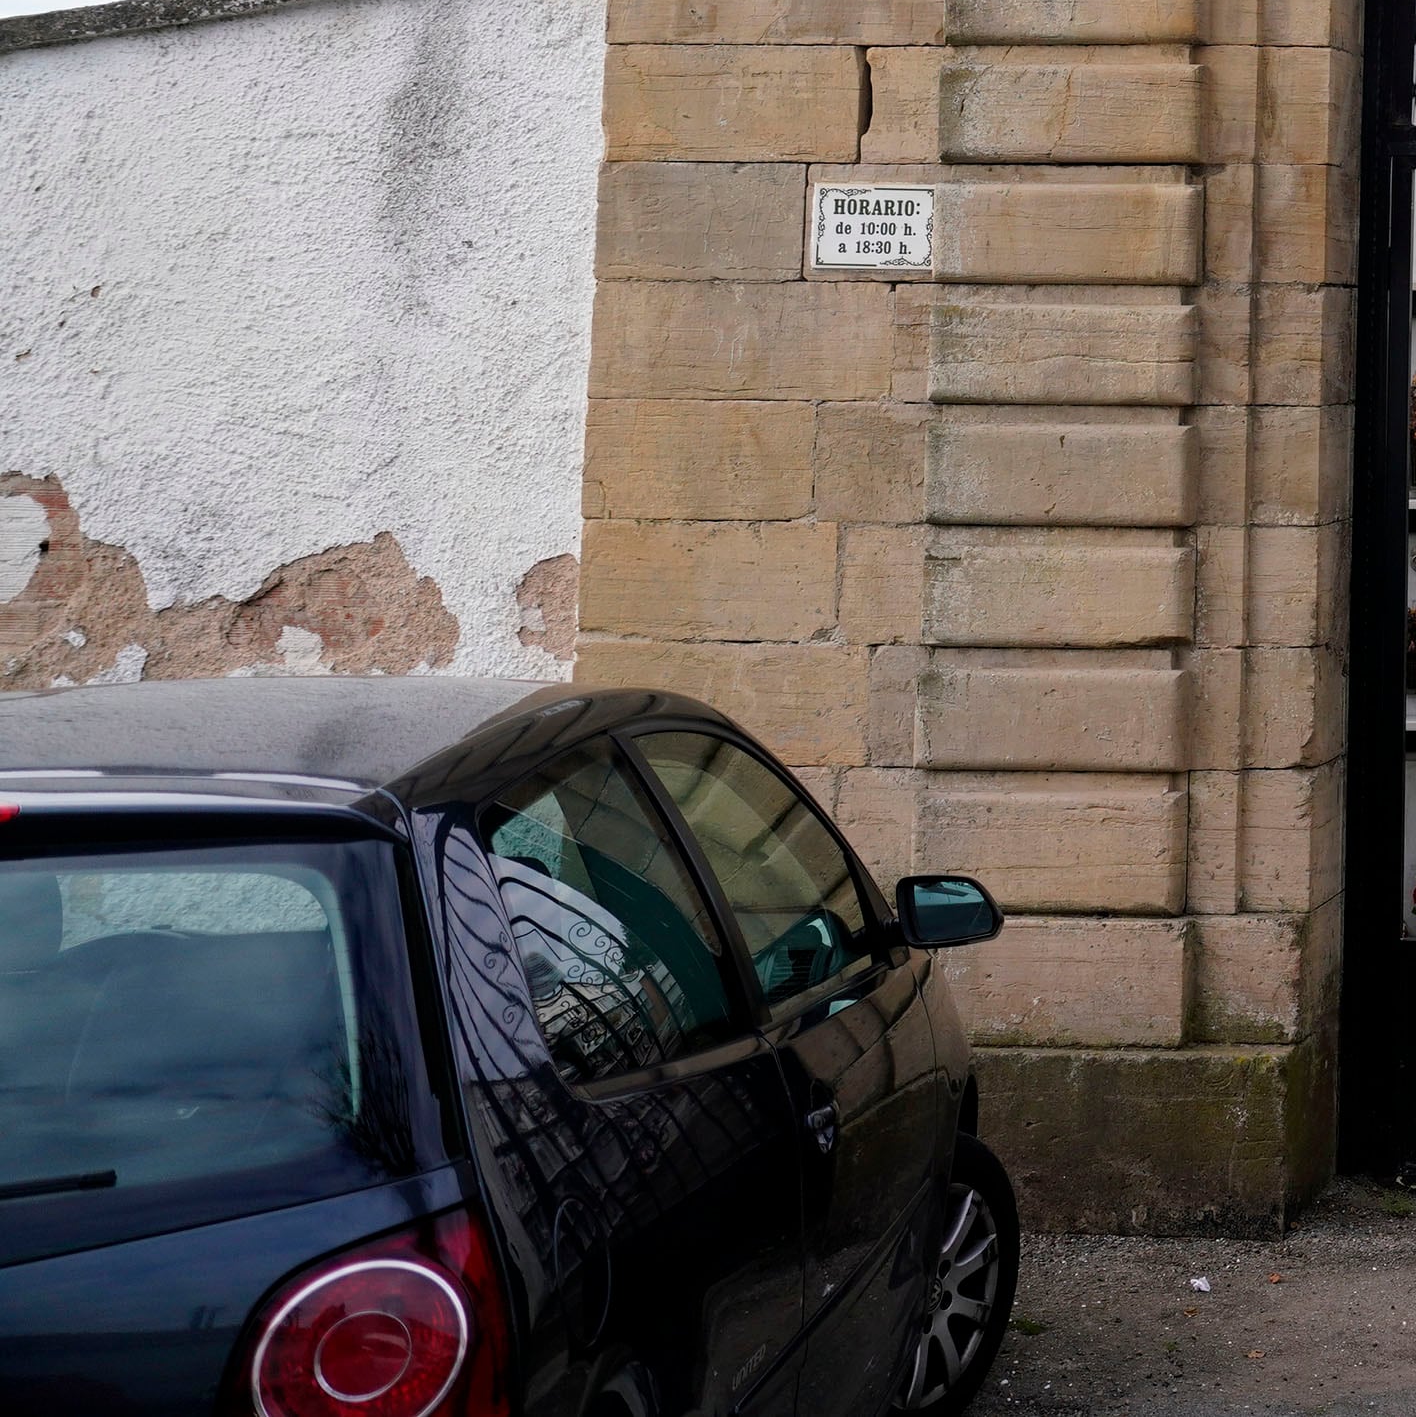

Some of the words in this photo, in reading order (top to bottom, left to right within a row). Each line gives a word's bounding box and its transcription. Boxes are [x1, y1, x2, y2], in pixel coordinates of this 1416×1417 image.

[833, 198, 921, 217] HORARIO:
[835, 221, 852, 235] de
[860, 222, 897, 236] 10:00
[903, 223, 917, 236] h.
[837, 243, 847, 254] a
[855, 240, 892, 255] 18:30
[898, 242, 912, 255] h.
